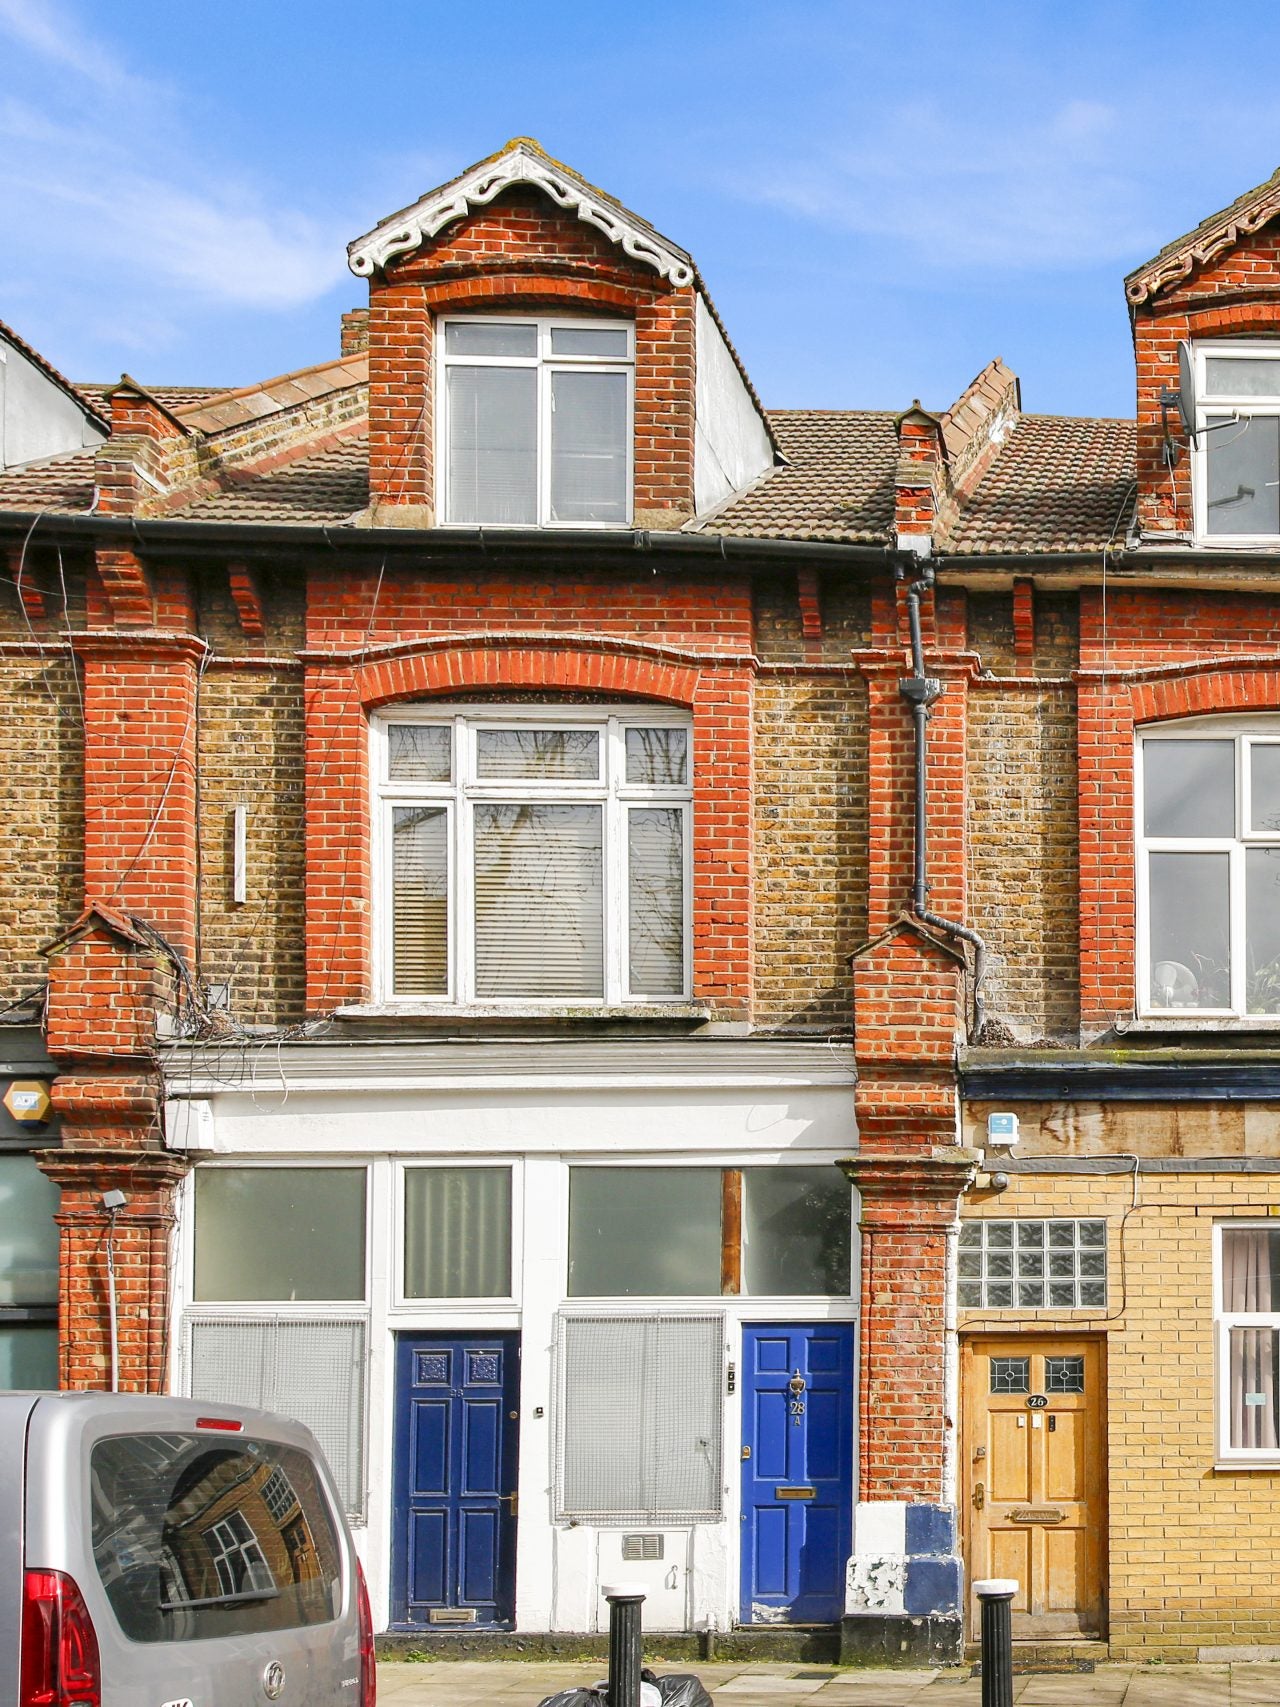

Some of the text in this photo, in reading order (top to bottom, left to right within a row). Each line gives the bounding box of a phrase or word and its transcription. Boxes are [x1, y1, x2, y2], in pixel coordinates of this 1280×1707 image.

[1030, 1397, 1044, 1406] 26
[790, 1401, 805, 1415] 28
[793, 1415, 801, 1426] A
